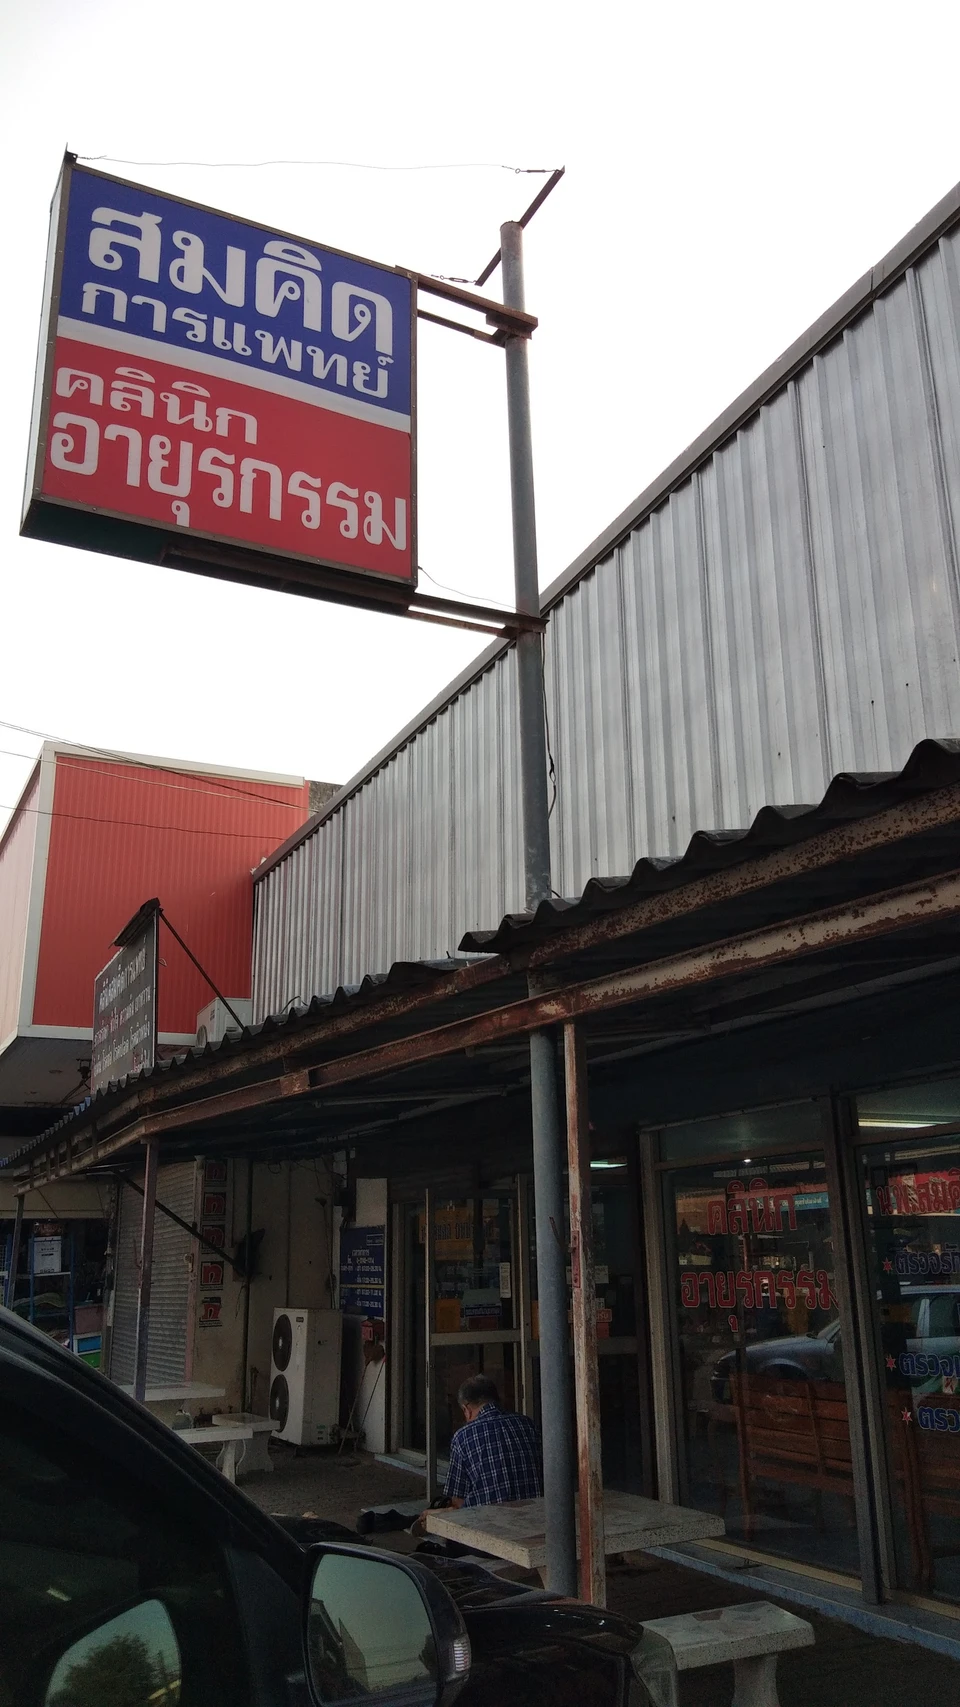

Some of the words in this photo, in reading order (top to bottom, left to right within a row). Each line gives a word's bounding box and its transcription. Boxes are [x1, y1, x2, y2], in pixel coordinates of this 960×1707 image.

[81, 280, 395, 399] การแพทย์
[88, 206, 394, 357] สมคิด
[55, 366, 258, 445] คลินิก
[50, 411, 407, 552] อายุรกรรม
[708, 1177, 798, 1235] คลินิก
